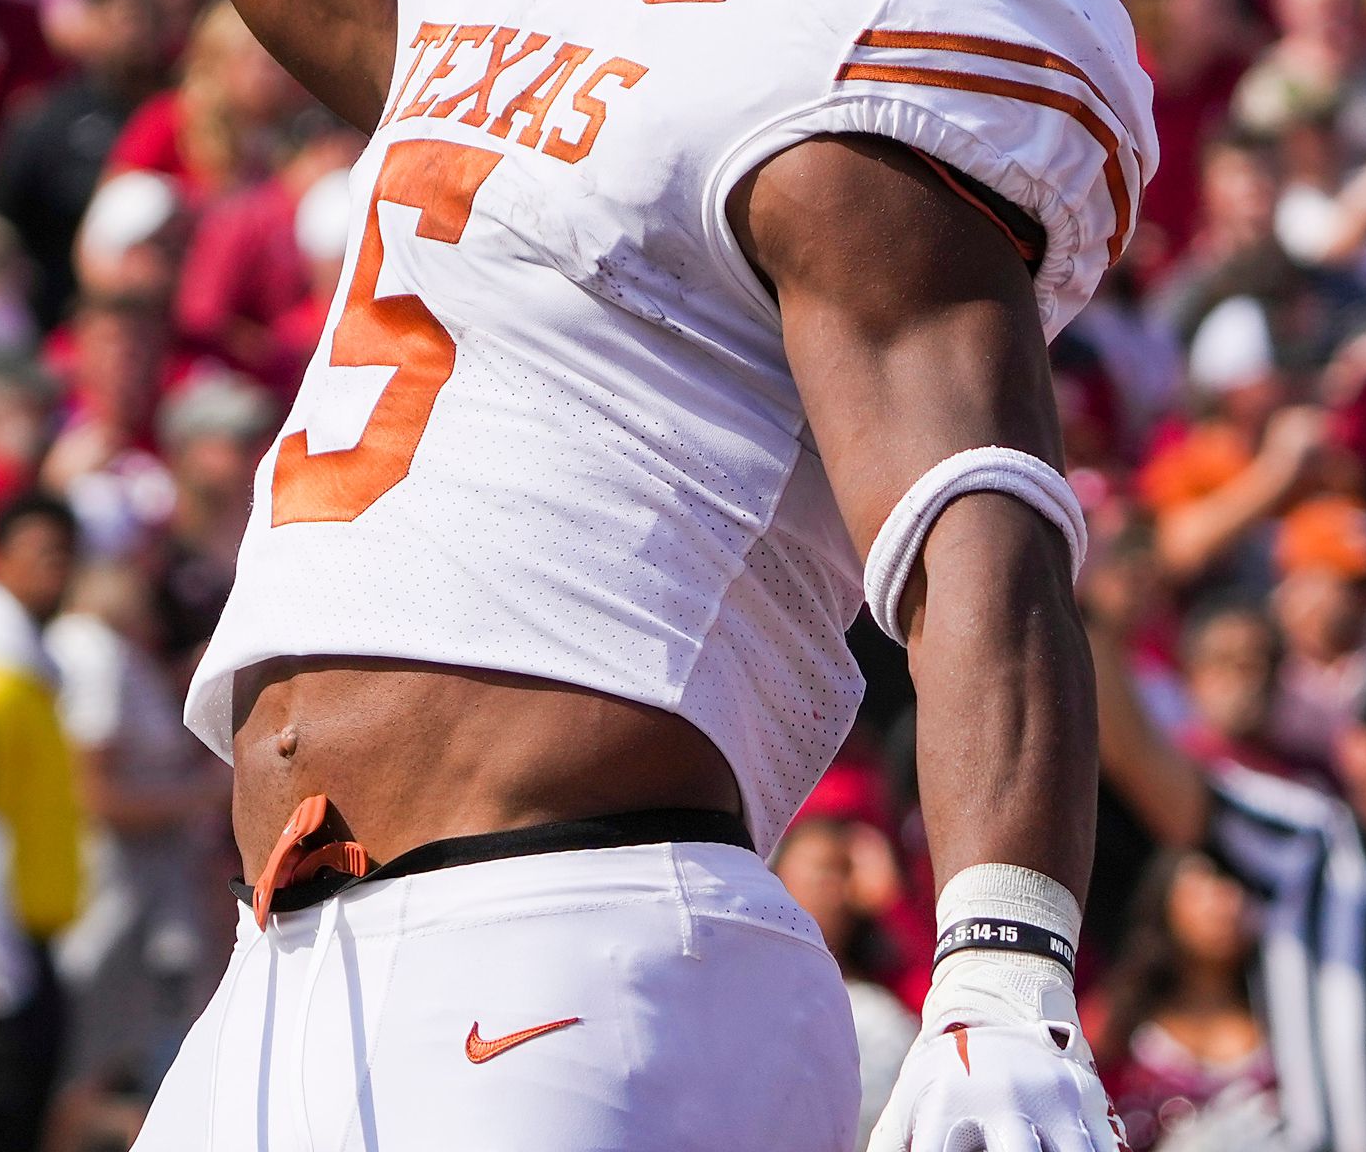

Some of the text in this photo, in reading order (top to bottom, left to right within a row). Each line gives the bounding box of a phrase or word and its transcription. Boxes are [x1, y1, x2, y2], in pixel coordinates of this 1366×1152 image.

[379, 21, 649, 164] TEXAS
[271, 138, 504, 528] 5
[955, 924, 1018, 942] 5:14-15
